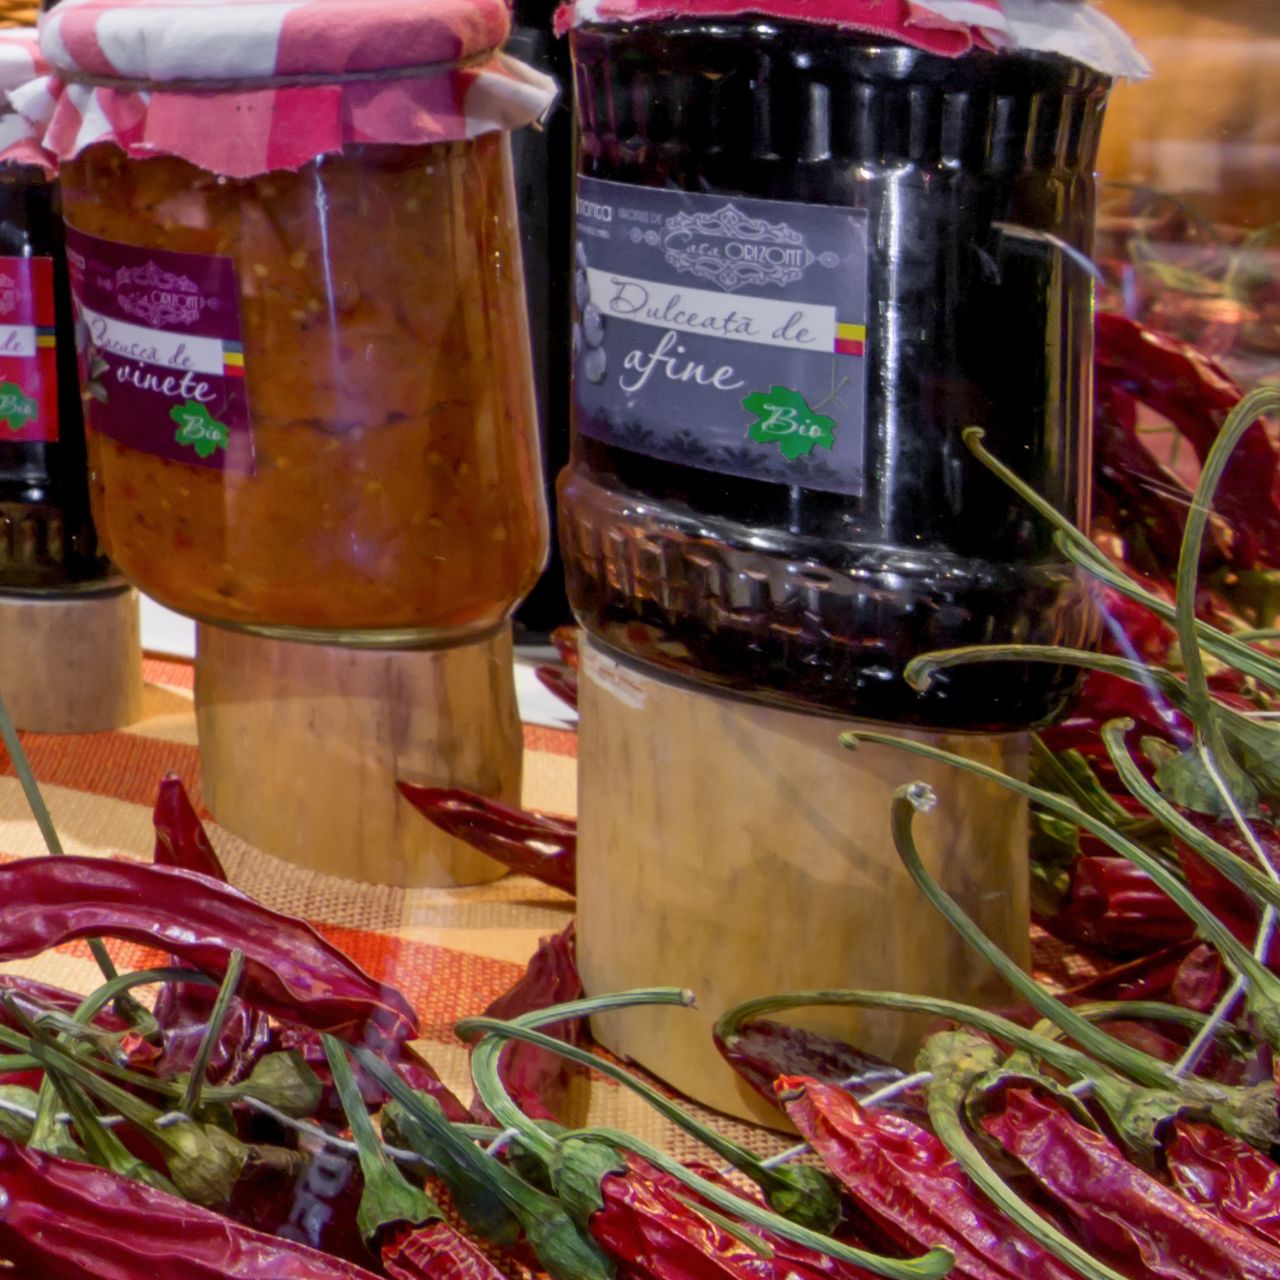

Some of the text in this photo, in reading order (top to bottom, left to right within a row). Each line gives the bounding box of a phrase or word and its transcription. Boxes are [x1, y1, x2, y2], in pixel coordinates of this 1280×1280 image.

[724, 240, 804, 268] ORIZONT
[0, 330, 24, 354] de
[771, 311, 817, 344] de
[167, 342, 196, 368] de
[618, 330, 745, 393] afine
[115, 361, 218, 403] vinete
[182, 412, 224, 441] Bio
[761, 403, 825, 439] Bio
